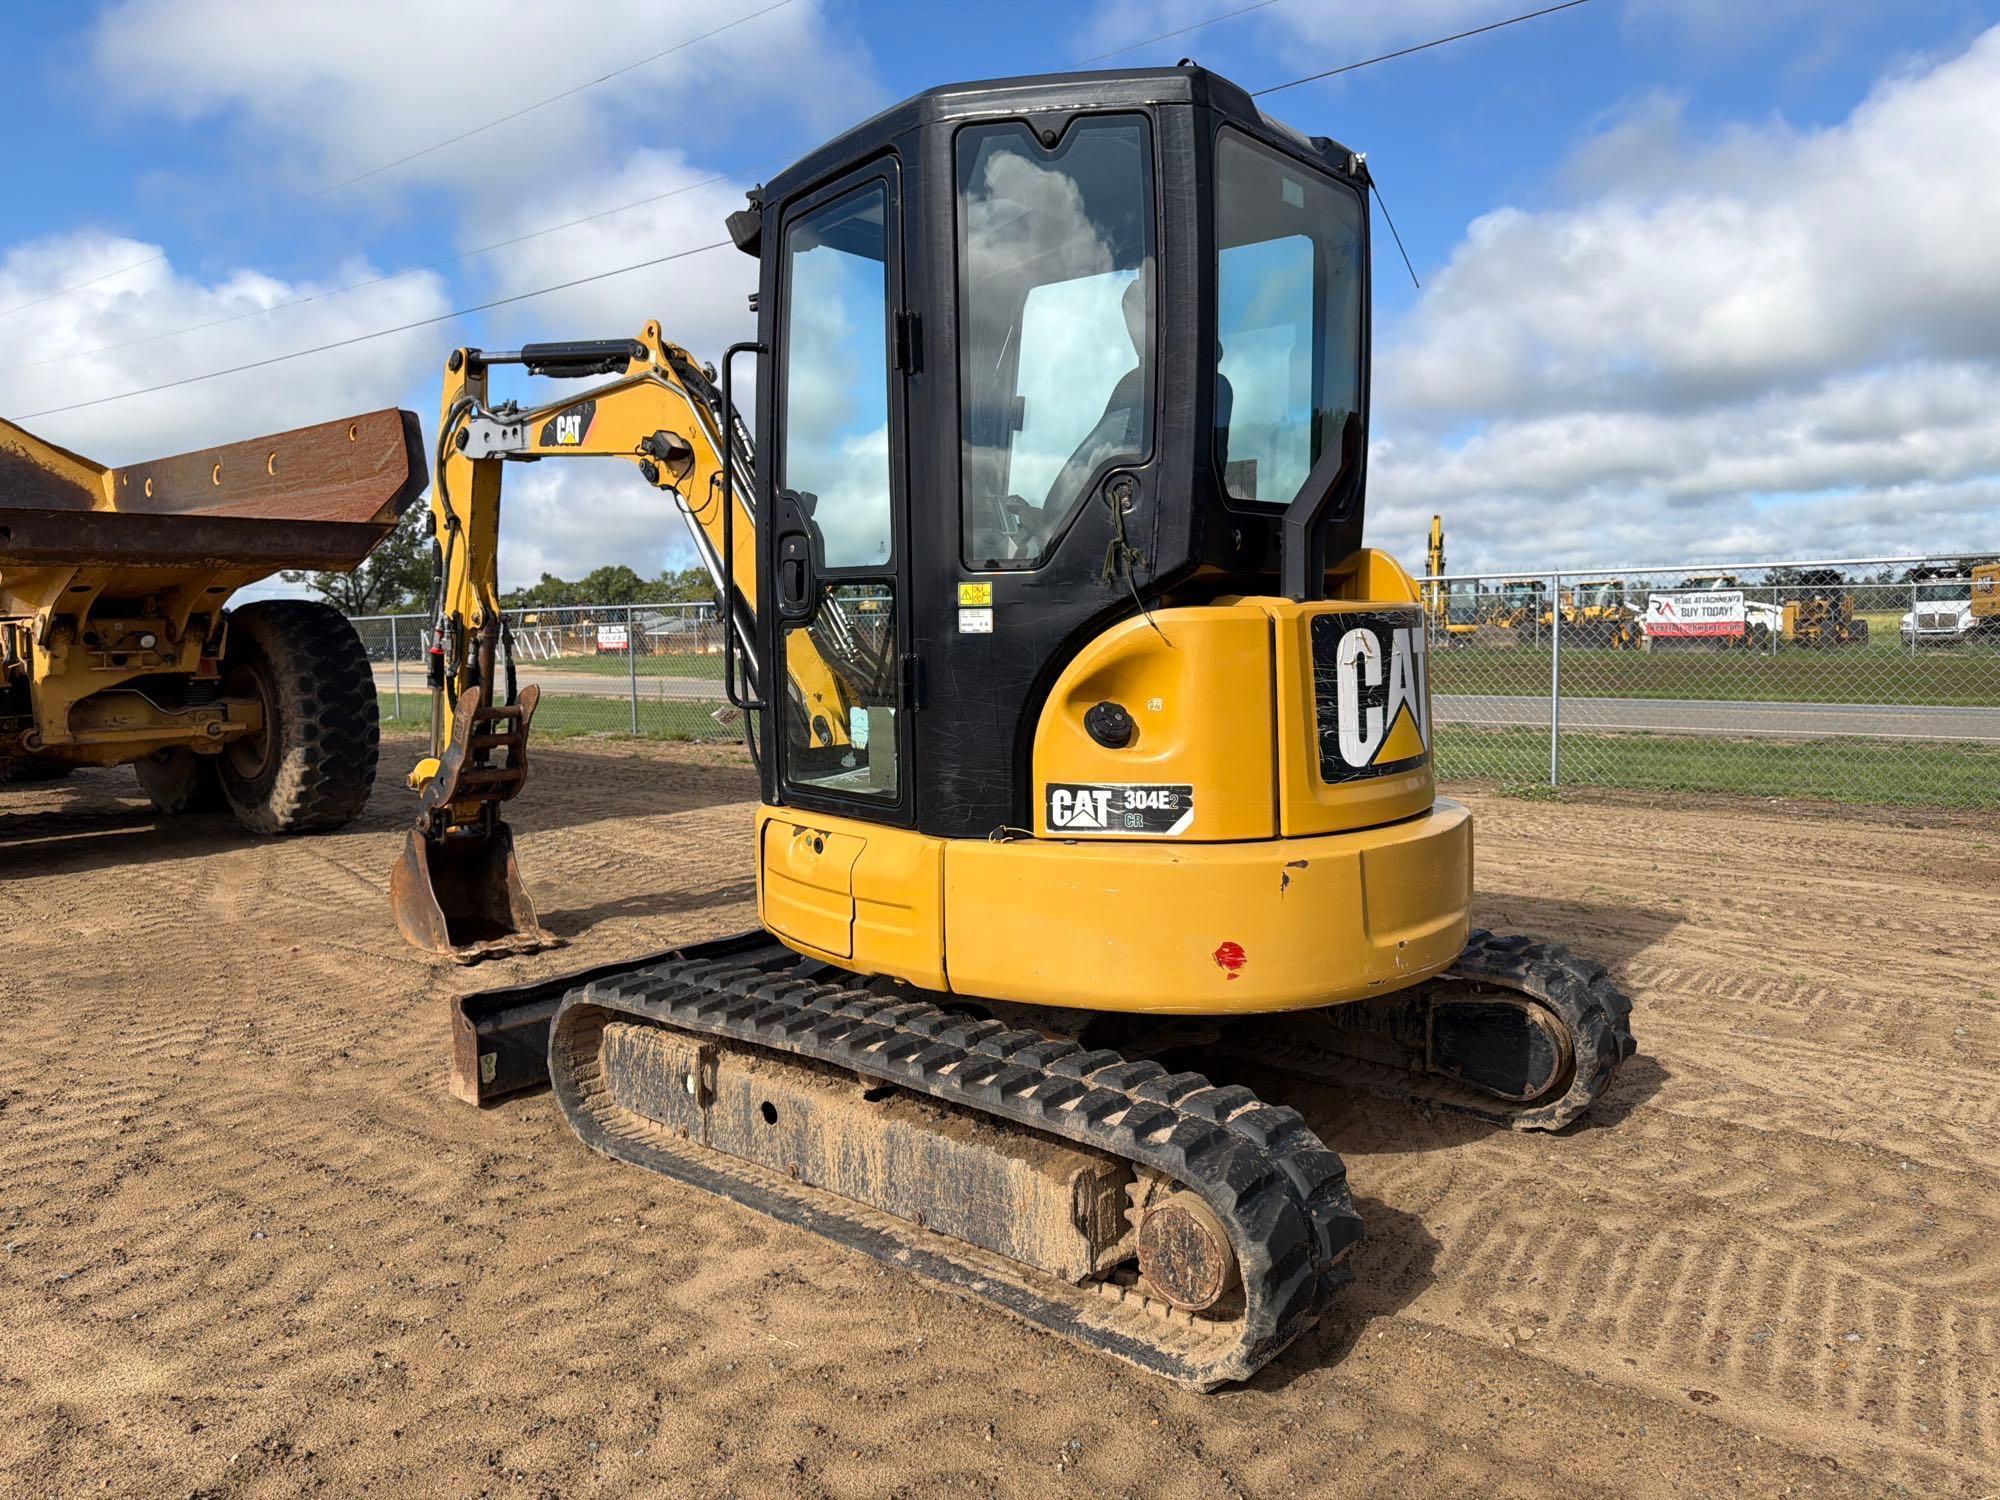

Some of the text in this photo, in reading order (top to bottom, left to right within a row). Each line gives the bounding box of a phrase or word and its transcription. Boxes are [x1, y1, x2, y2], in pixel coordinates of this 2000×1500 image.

[556, 415, 581, 444] CAT
[1681, 605, 1733, 617] BUY TODAY!
[1337, 628, 1428, 767] CAT
[1052, 789, 1179, 827] CAT 304E2
[1124, 813, 1144, 828] CR
